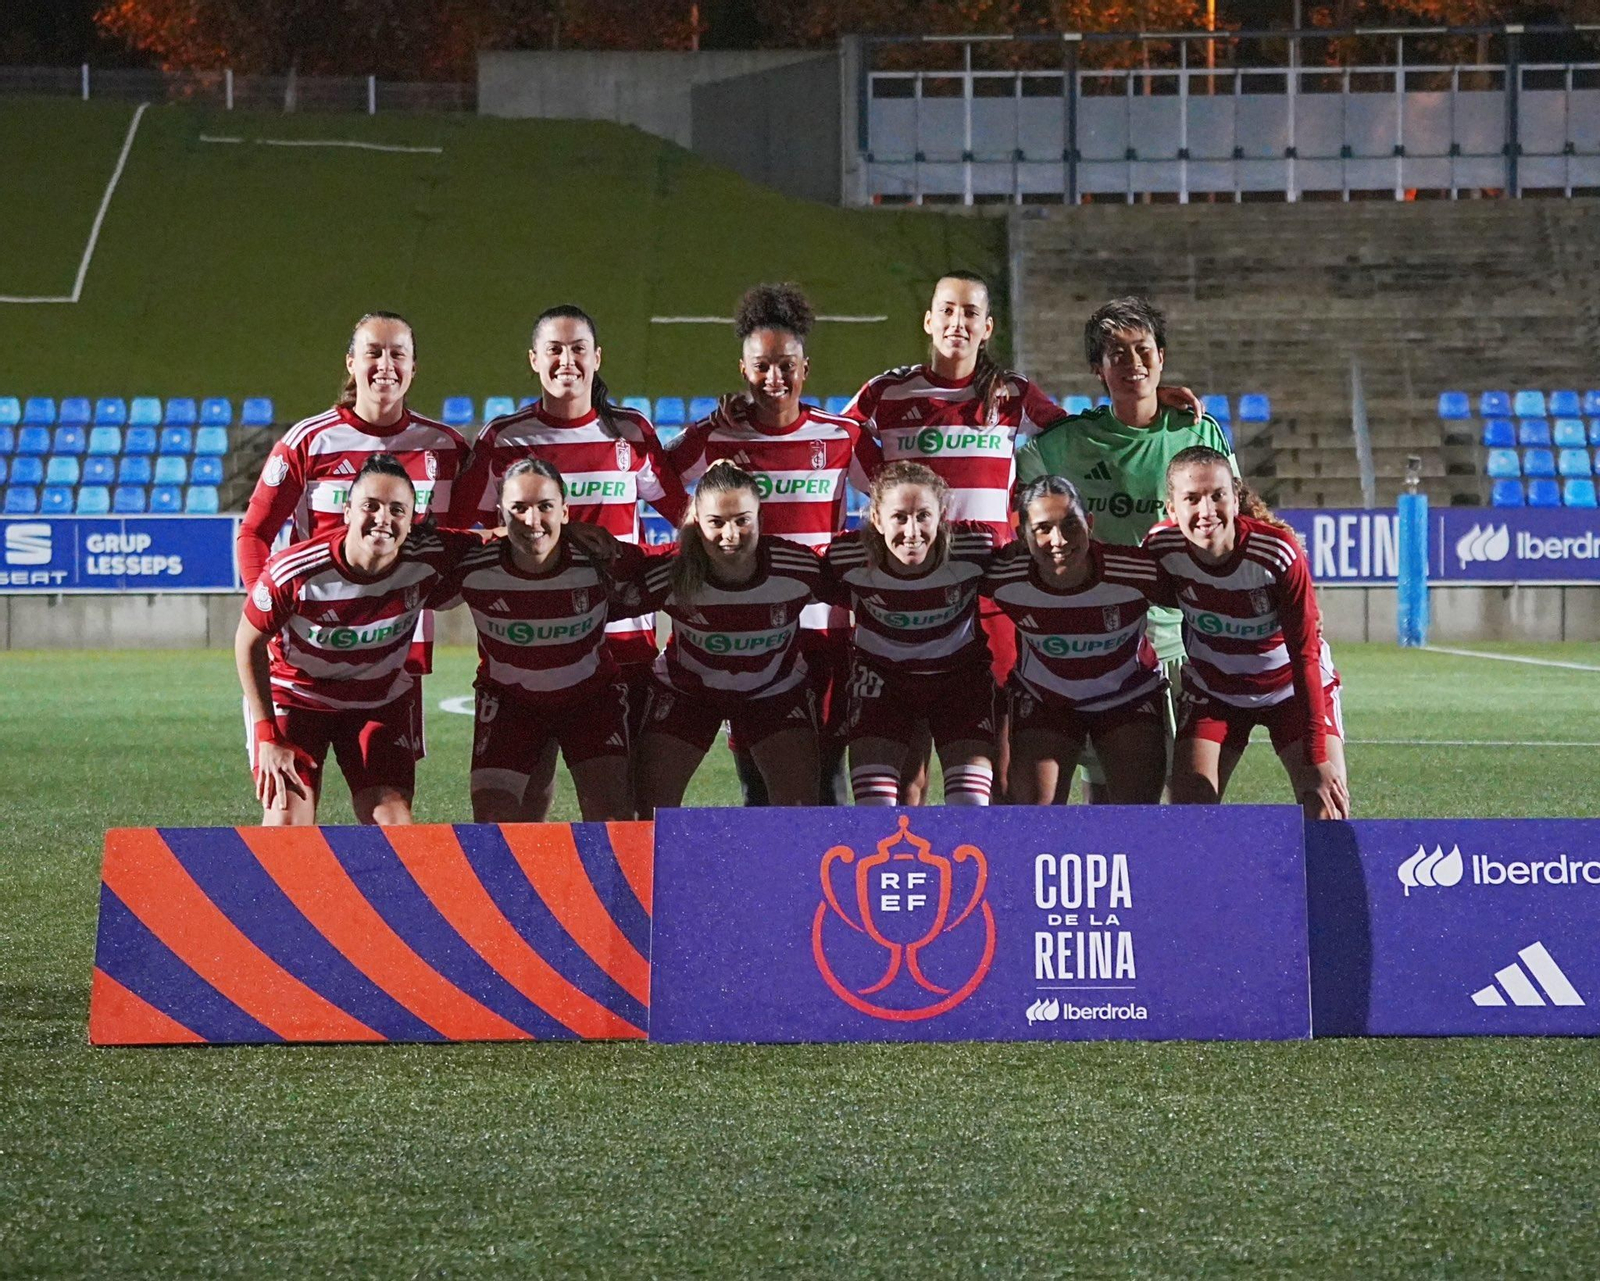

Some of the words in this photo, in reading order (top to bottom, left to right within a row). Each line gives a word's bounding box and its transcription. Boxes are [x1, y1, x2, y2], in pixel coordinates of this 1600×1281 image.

[562, 480, 626, 497] UPER
[1108, 492, 1168, 518] SUP
[86, 533, 152, 554] GRUP
[1313, 514, 1430, 578] REIN
[86, 555, 184, 576] LESSEPS
[1034, 853, 1133, 910] COPA
[1048, 913, 1079, 926] DE
[1089, 913, 1121, 926] LA
[1034, 931, 1136, 980] REINA
[1062, 1002, 1148, 1021] Iberdrola
